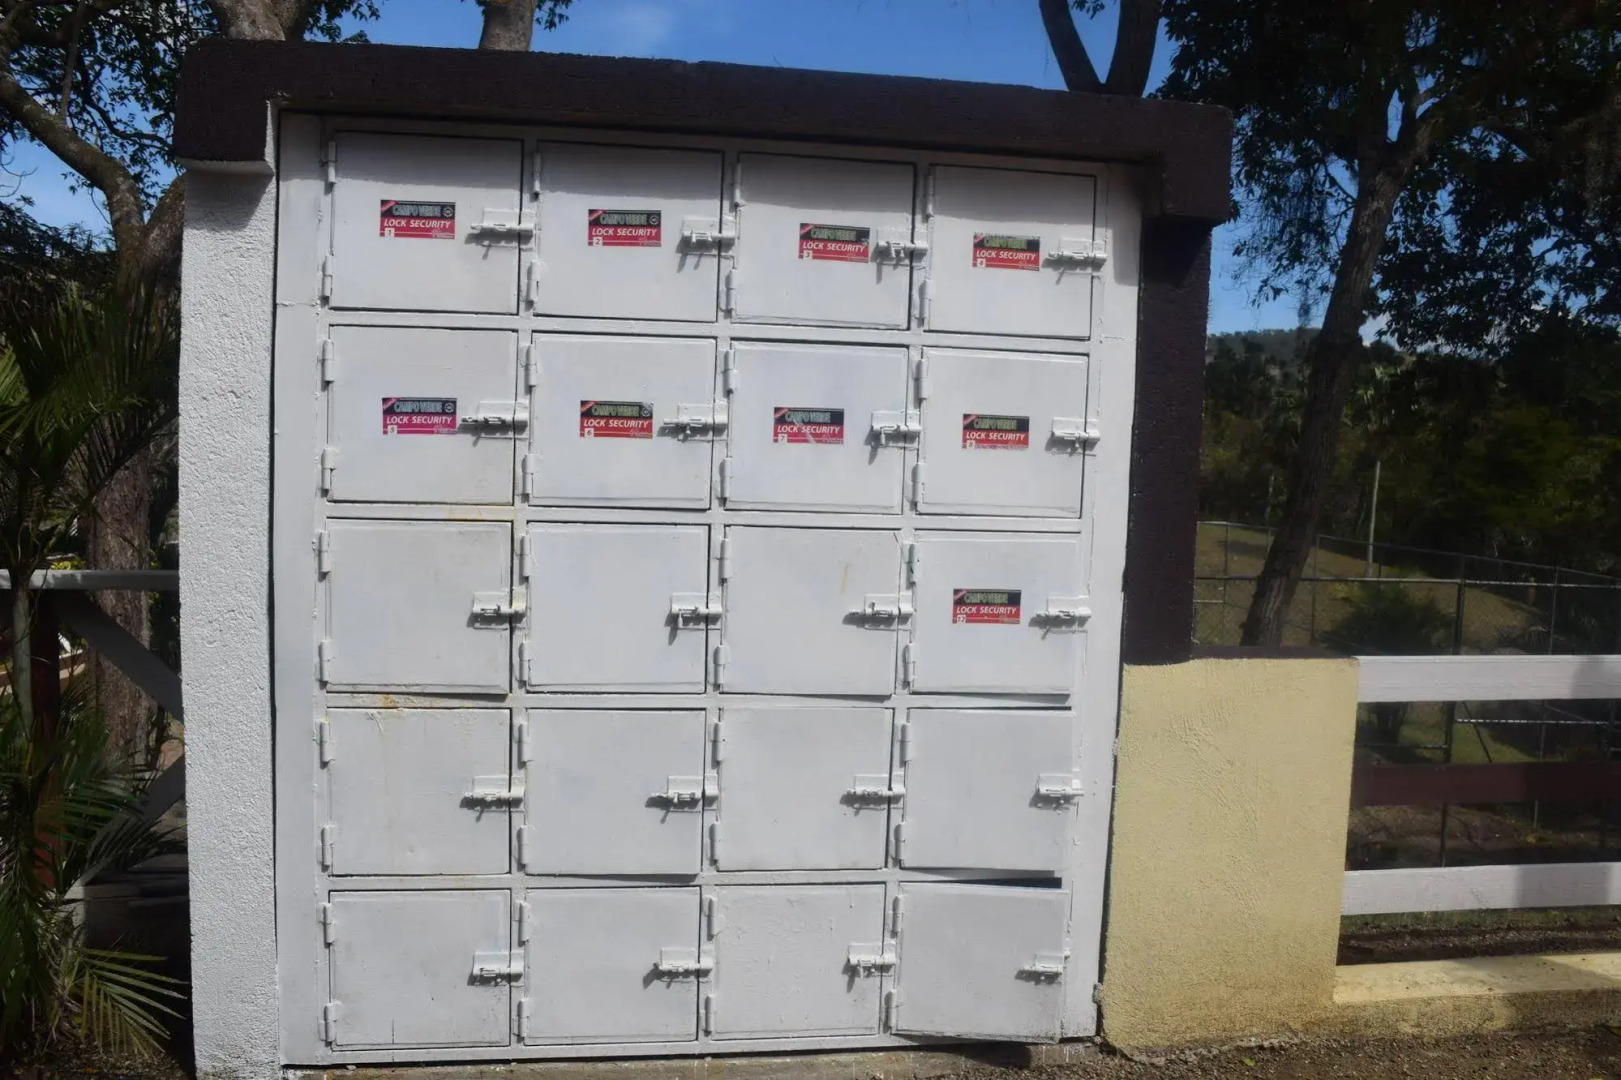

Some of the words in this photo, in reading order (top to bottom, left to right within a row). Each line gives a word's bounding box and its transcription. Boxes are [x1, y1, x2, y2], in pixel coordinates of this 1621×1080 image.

[409, 220, 451, 228] SECURITY
[827, 243, 865, 252] SECURITY
[999, 251, 1036, 260] SECURITY
[608, 420, 649, 428] SECURITY
[801, 426, 840, 434] SECURITY
